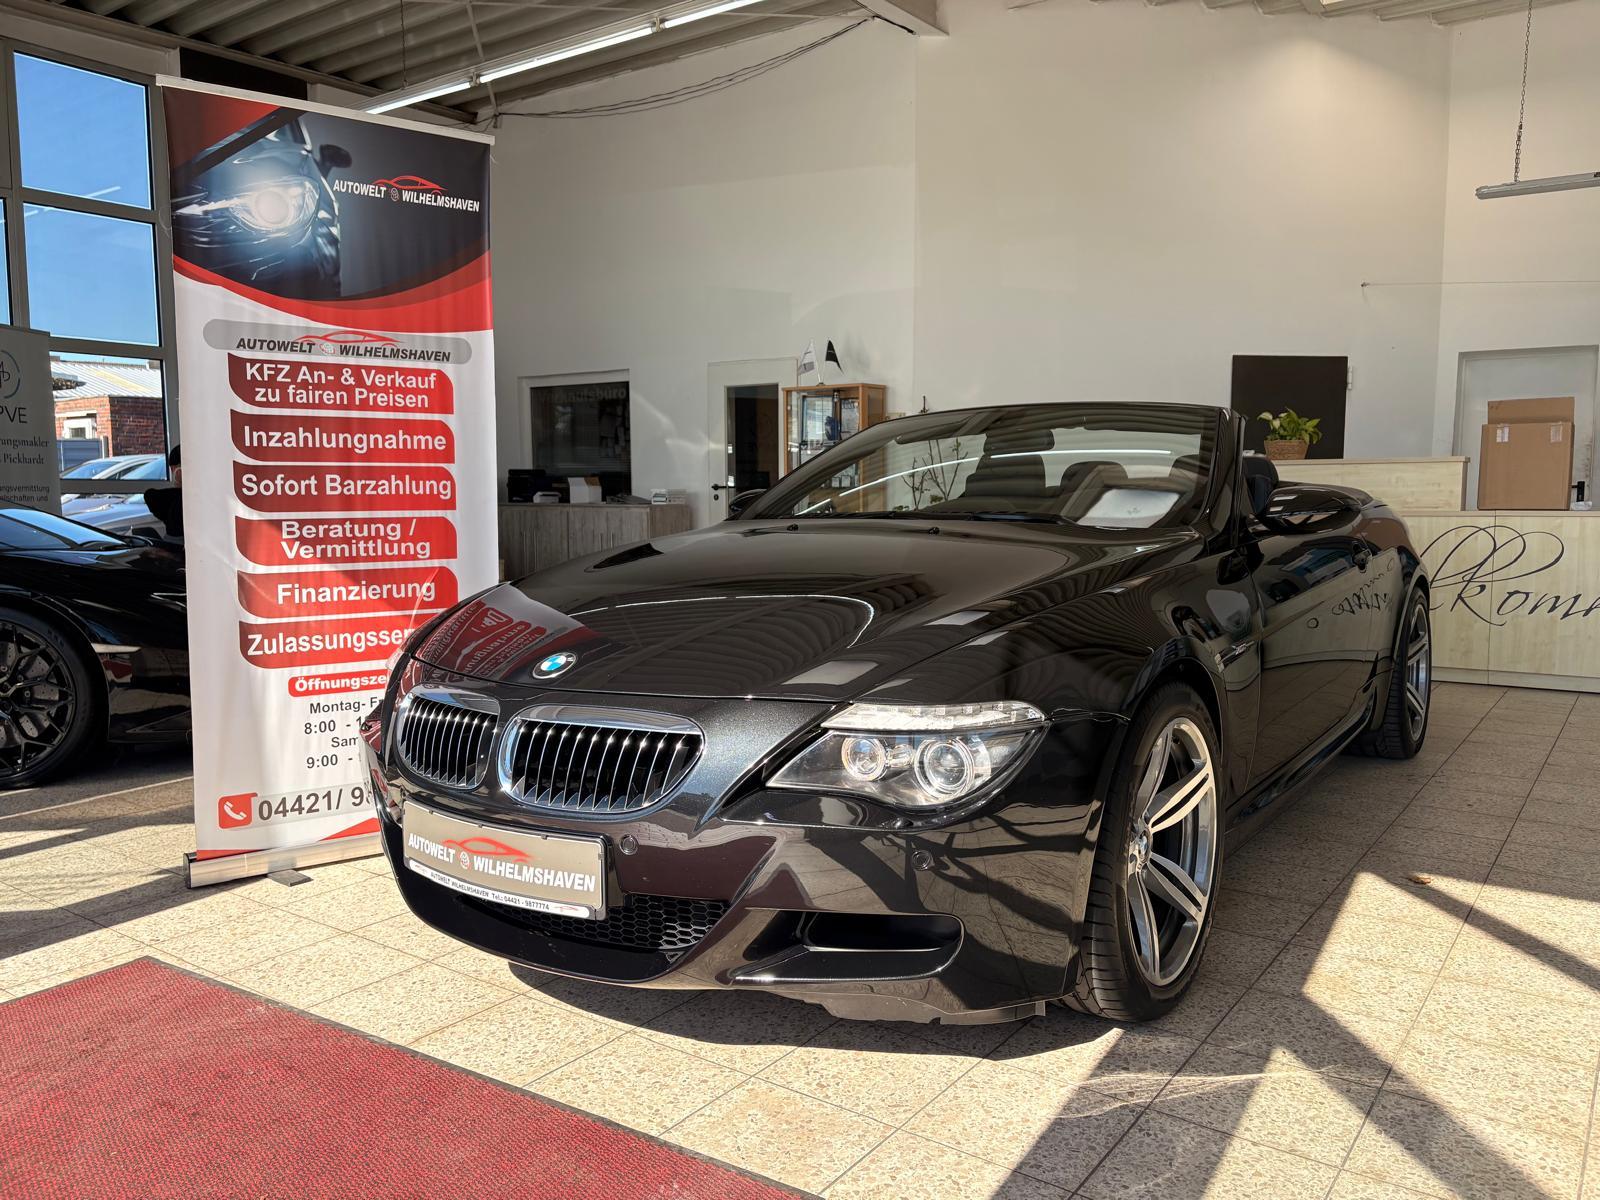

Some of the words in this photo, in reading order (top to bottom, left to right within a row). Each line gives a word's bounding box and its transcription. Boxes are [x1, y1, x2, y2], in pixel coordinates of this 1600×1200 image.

[333, 180, 387, 199] AUTOWELT
[402, 190, 480, 213] WILHELMSHAVEN
[236, 338, 315, 354] AUTOWELT
[339, 344, 451, 362] WILHELMSHAVEN
[246, 362, 292, 382] KFZ
[297, 364, 335, 384] An-
[340, 367, 356, 386] &
[361, 369, 437, 389] Verkauf
[255, 386, 280, 402] zu
[287, 385, 348, 405] fairen
[355, 387, 429, 408] Preisen
[244, 425, 447, 454] Inzahlungnahme
[242, 474, 318, 496] Sofort
[325, 474, 452, 499] Barzahlung
[281, 521, 402, 540] Beratung
[409, 519, 417, 536] /
[280, 540, 431, 559] Vermittlung
[277, 581, 436, 605] Finanzierung
[247, 628, 415, 656] Zulassungsser
[295, 674, 387, 692] Öffnungsze
[309, 700, 366, 714] Montag-
[304, 720, 336, 734] 8:00
[331, 736, 359, 748] Sam
[306, 754, 338, 769] 9:00
[408, 833, 456, 864] AUTOWELT
[473, 855, 596, 892] WILHELMSHAVEN
[430, 873, 450, 885] AUTOWELT
[451, 880, 489, 897] WILHELMSHAVEN
